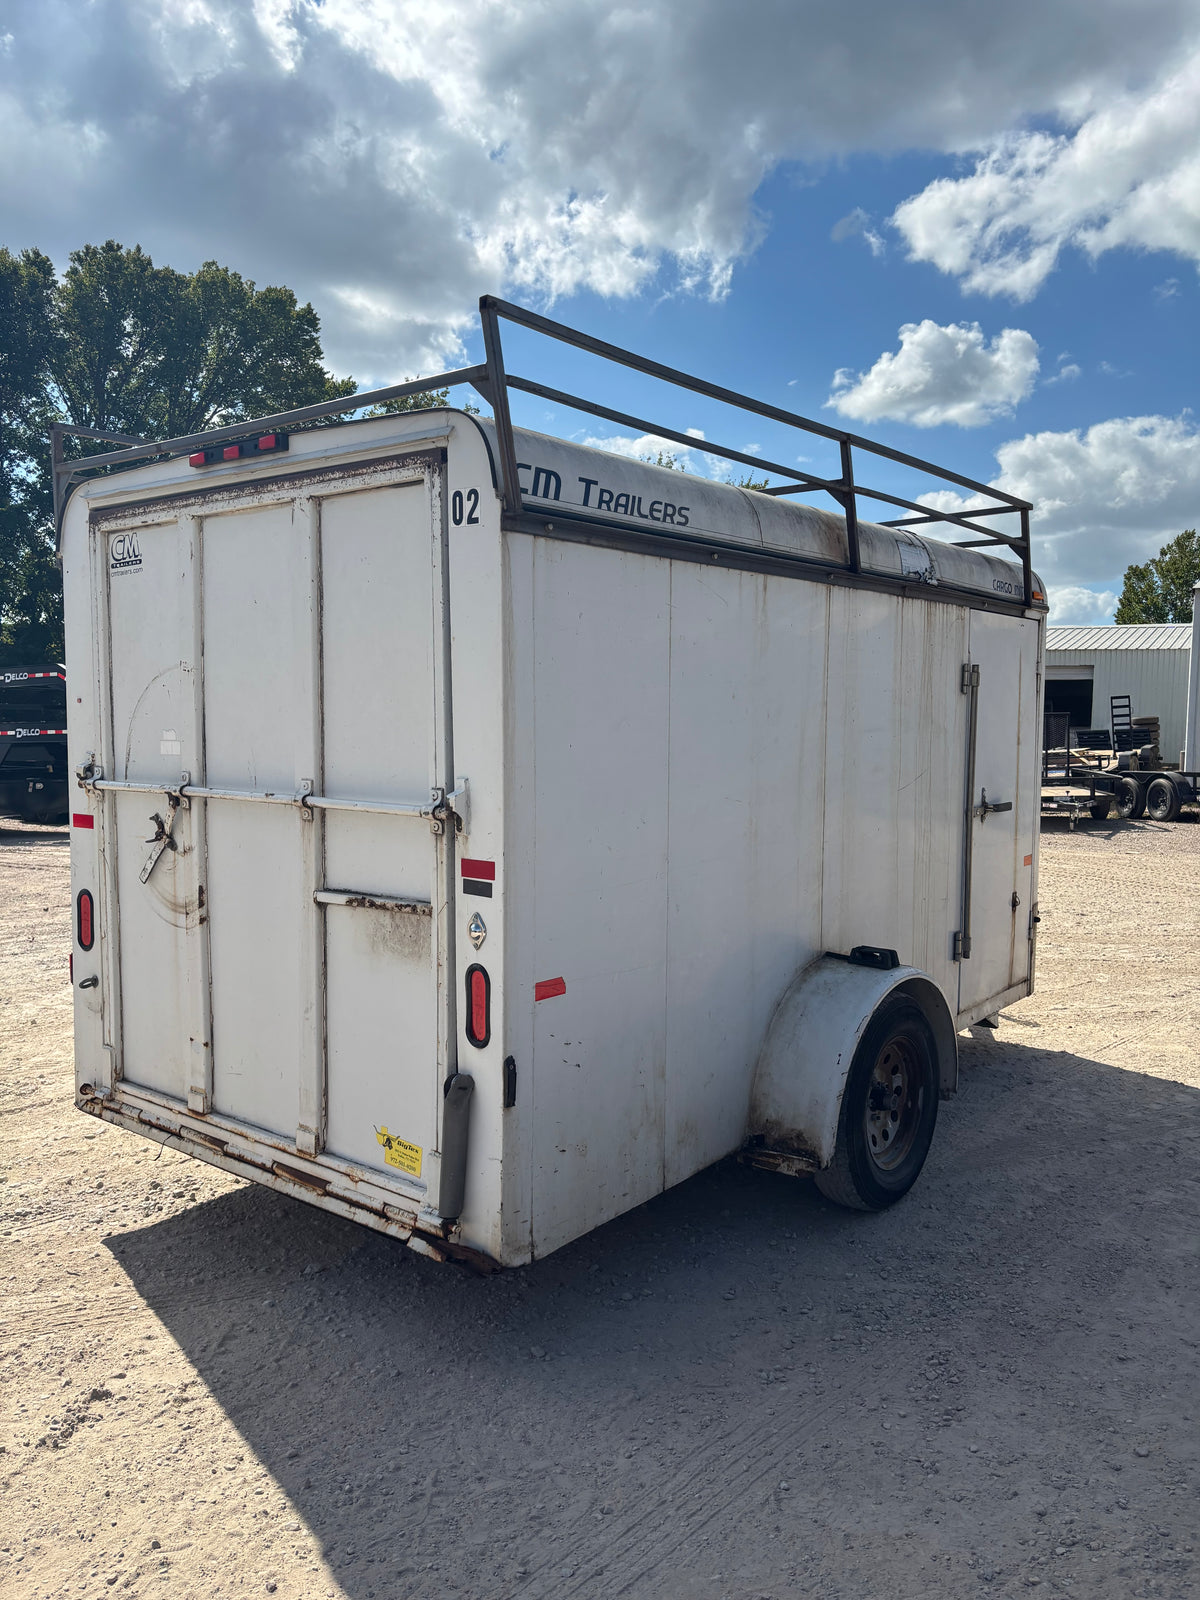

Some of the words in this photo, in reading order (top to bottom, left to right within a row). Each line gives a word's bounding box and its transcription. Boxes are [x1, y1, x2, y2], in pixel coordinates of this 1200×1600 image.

[452, 488, 480, 526] 02
[111, 532, 139, 562] CM
[992, 579, 1013, 594] CARGO
[4, 672, 29, 683] DELCO
[15, 728, 41, 739] DELCO
